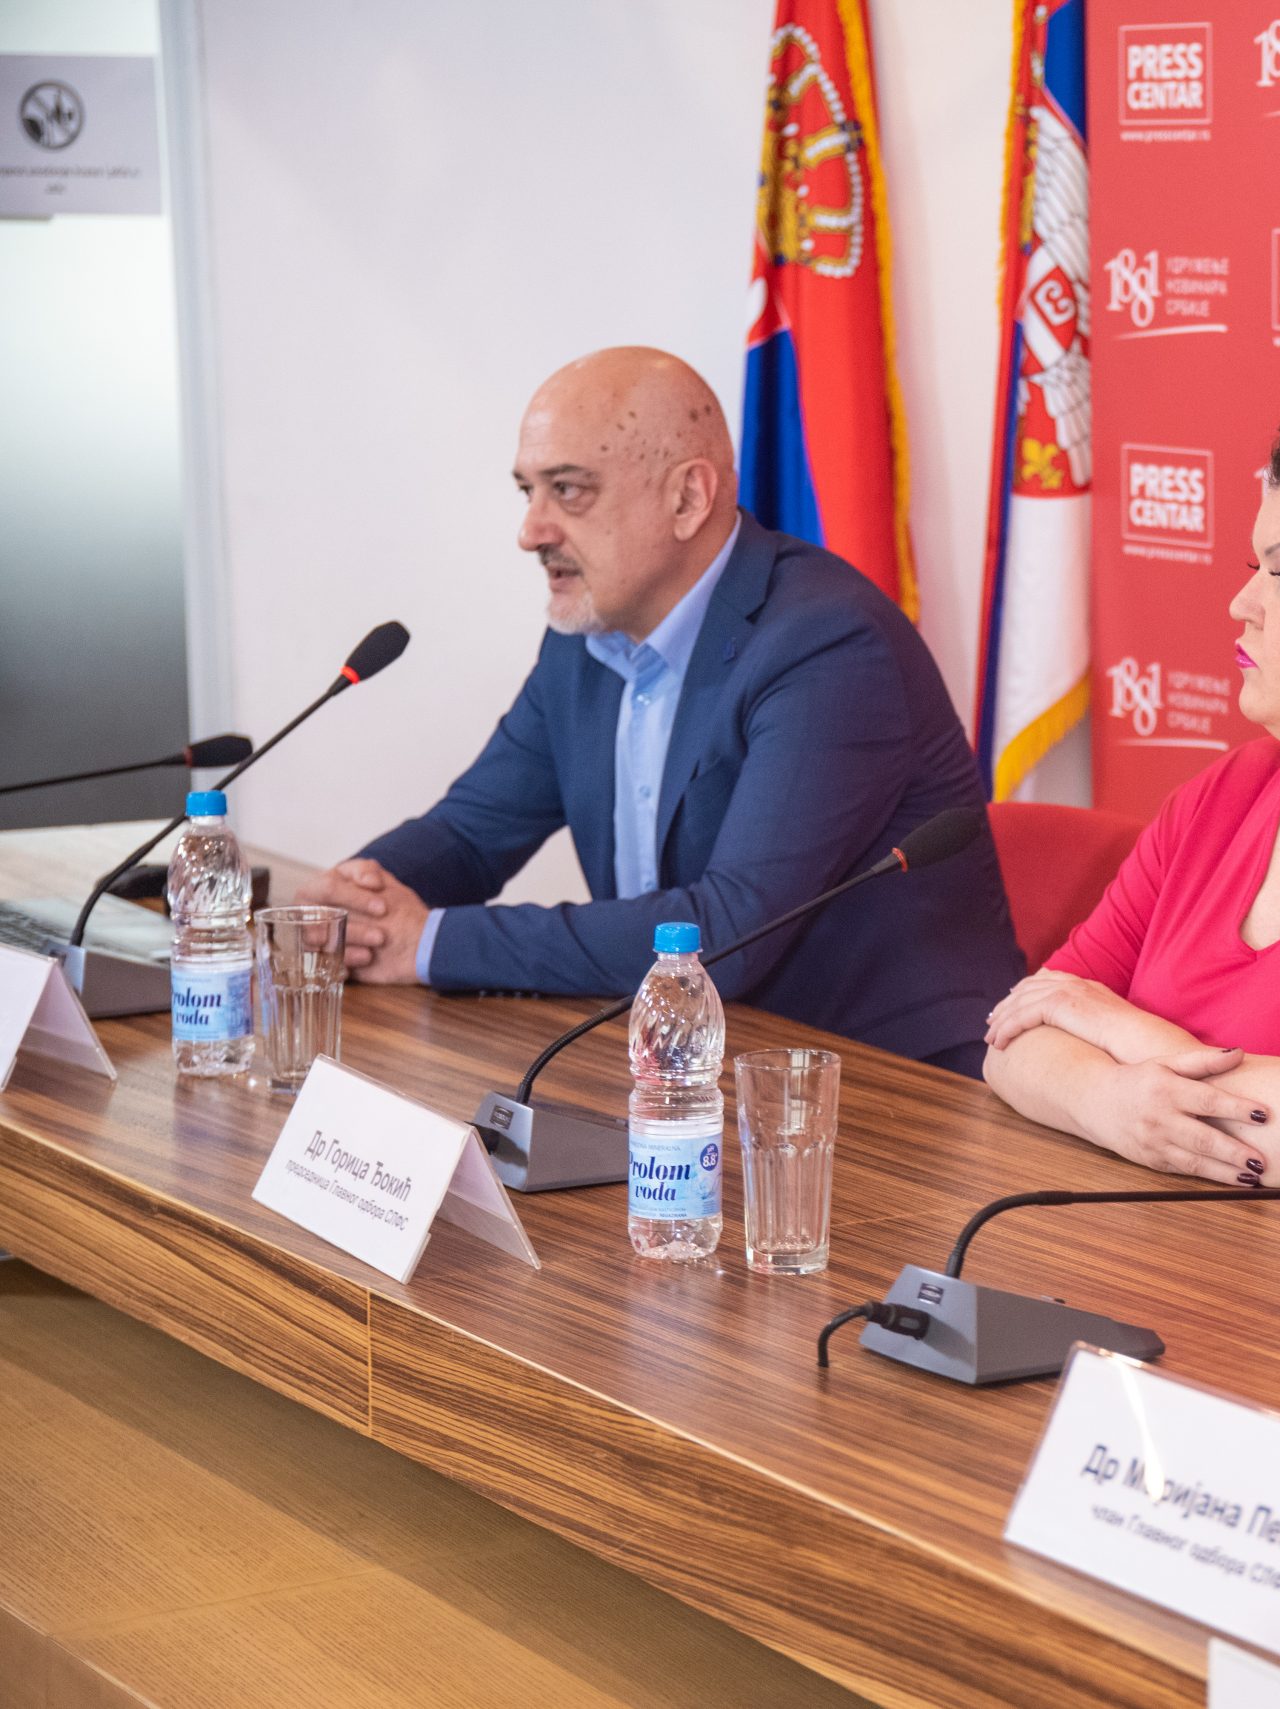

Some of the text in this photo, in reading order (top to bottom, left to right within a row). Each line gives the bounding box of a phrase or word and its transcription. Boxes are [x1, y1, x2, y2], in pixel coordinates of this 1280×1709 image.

[1127, 44, 1203, 79] PRESS
[1127, 81, 1203, 109] CENTAR
[1130, 462, 1205, 503] PRESS
[1130, 502, 1205, 533] CENTAR
[173, 987, 221, 1008] rolom
[304, 1129, 412, 1202] Др Горица Ђокић
[635, 1181, 677, 1201] voda
[1080, 1443, 1120, 1485] Др
[1122, 1457, 1242, 1529] Мријана
